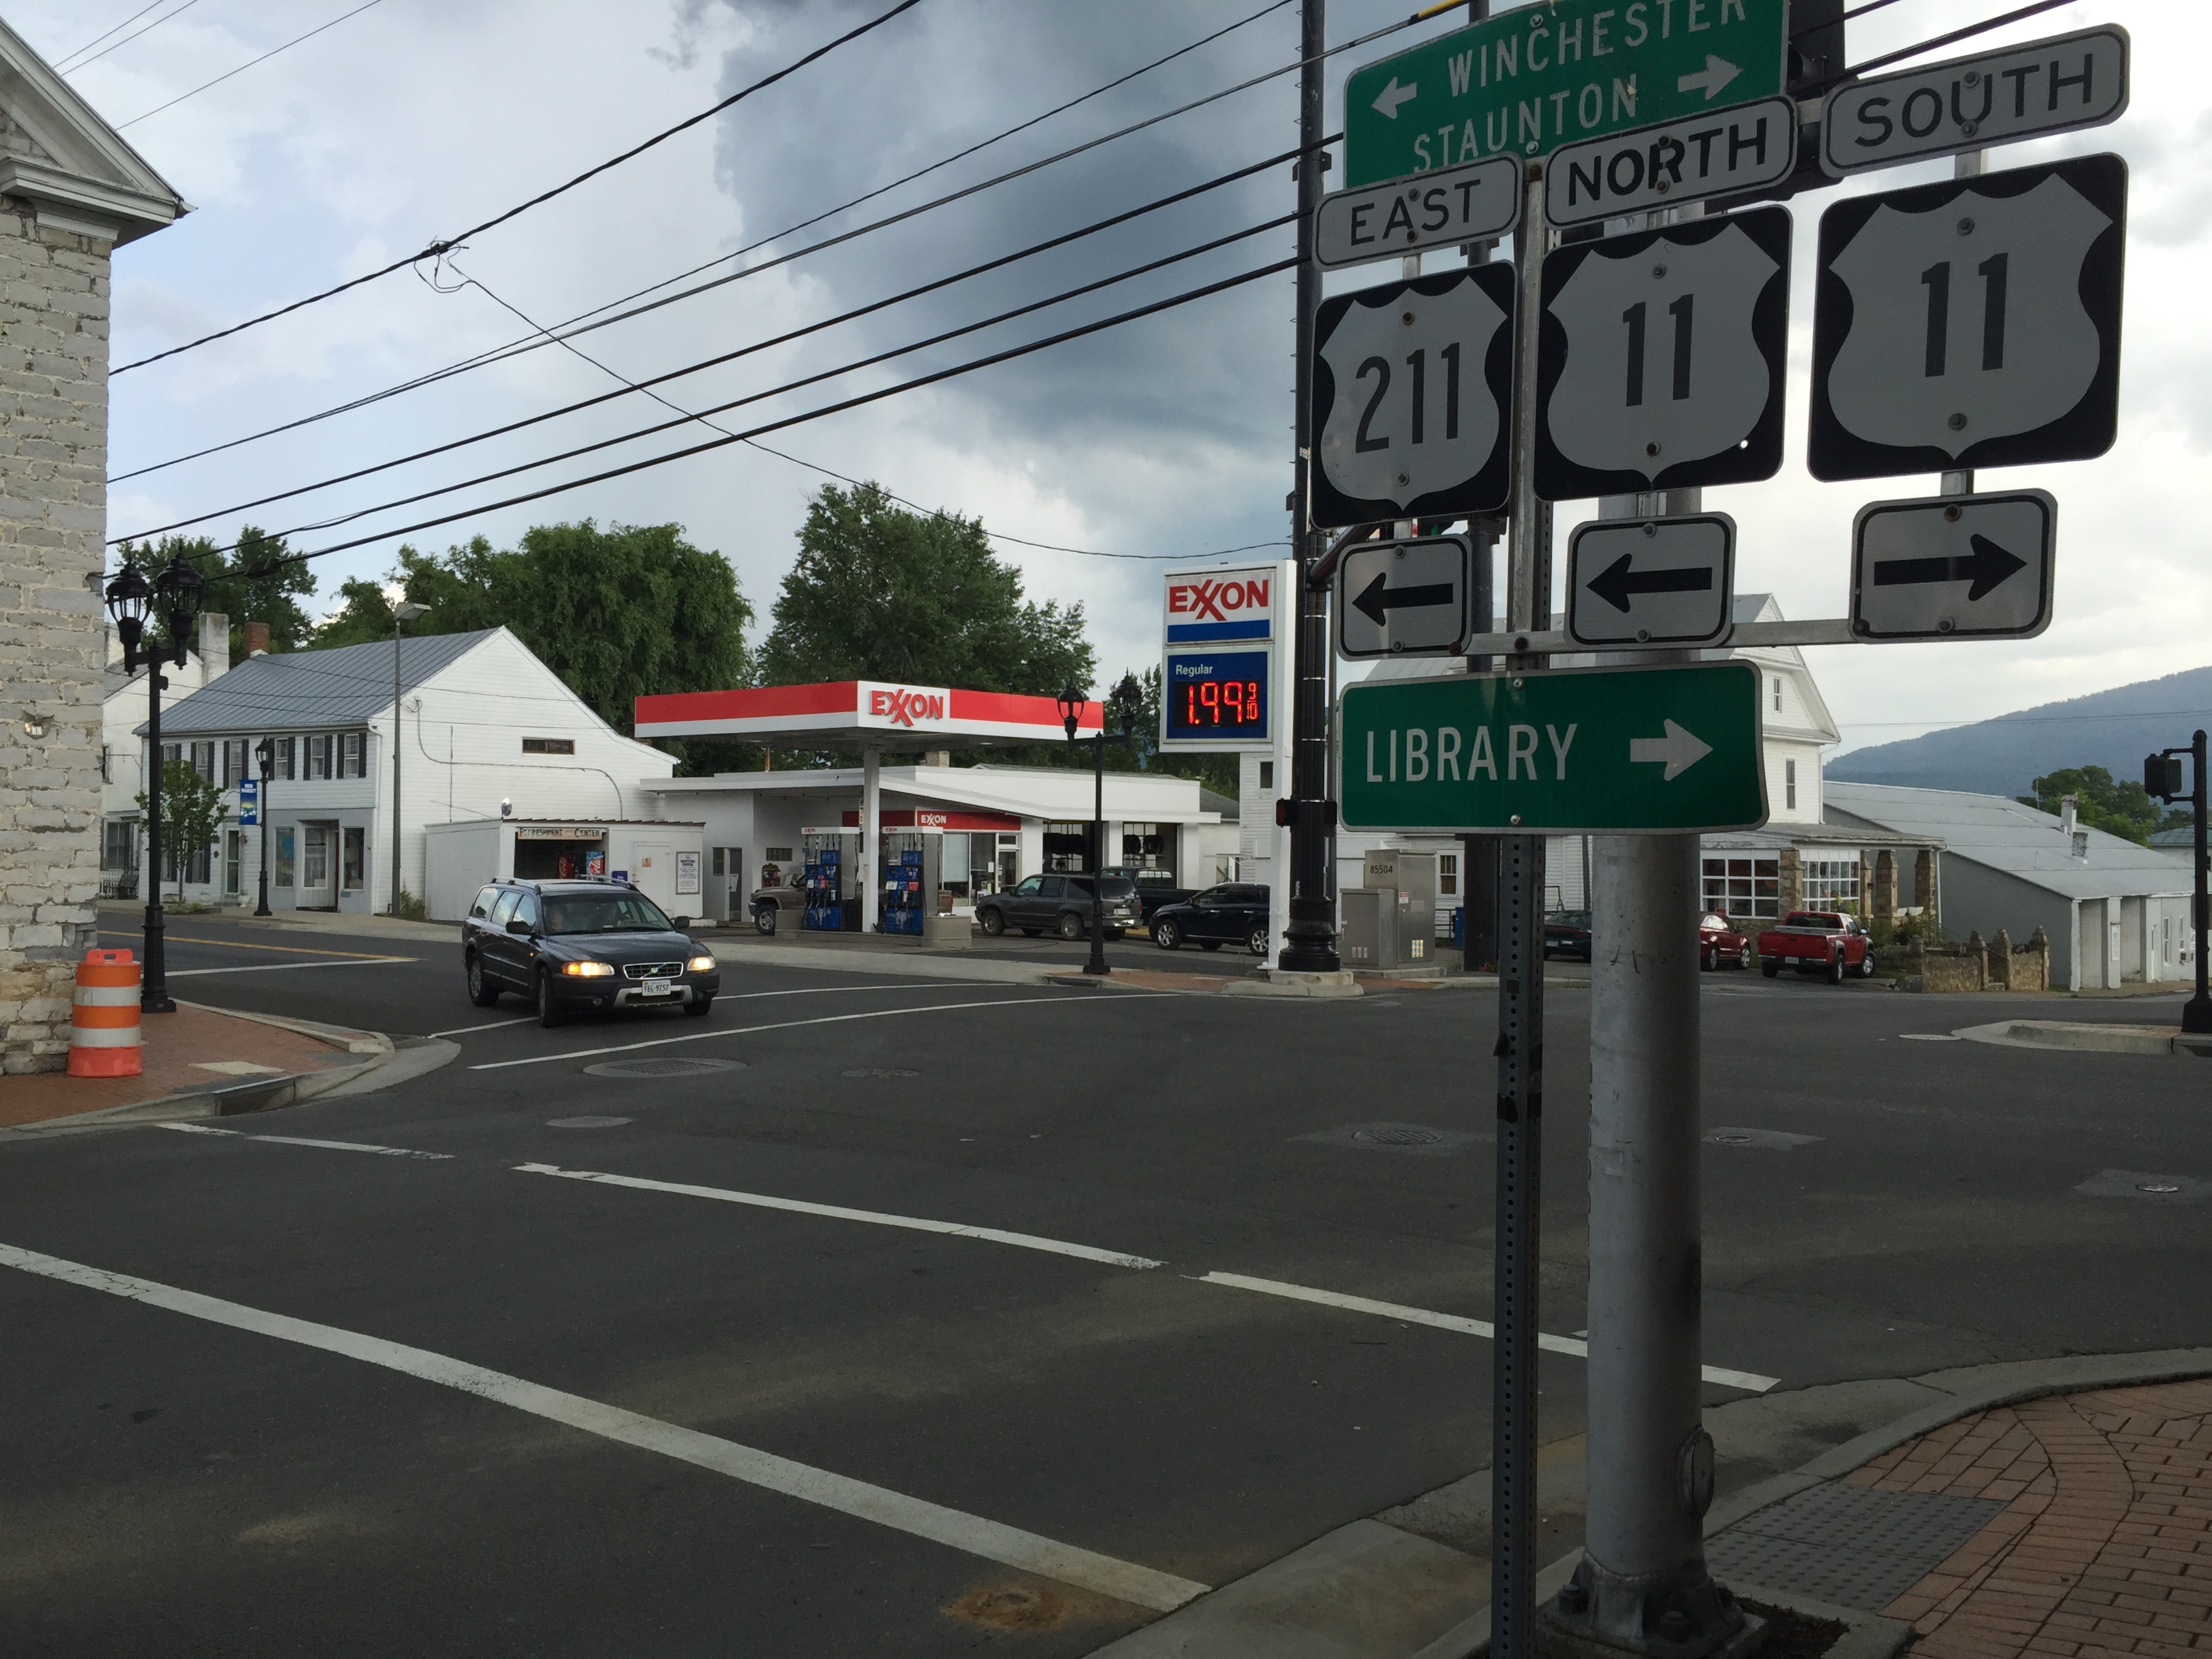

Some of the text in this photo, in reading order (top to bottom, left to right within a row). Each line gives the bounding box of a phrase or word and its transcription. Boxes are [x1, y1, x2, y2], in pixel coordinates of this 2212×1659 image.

[1448, 0, 1746, 97] WINCHESTER
[1413, 73, 1637, 174] STAUNTON
[1854, 53, 2093, 147] SOUTH
[1568, 117, 1767, 207] NORTH
[1351, 179, 1481, 247] EAST
[1921, 252, 2009, 377] 11
[1622, 293, 1694, 407] 11
[1355, 342, 1460, 454] 211
[1168, 579, 1269, 621] EXXON
[1175, 663, 1214, 678] Regular
[869, 688, 944, 727] EXXON
[1188, 682, 1242, 724] 1.99
[1366, 723, 1578, 783] LIBRARY
[574, 827, 600, 838] CENTER
[920, 813, 947, 827] EXXON
[1370, 865, 1393, 874] 85504
